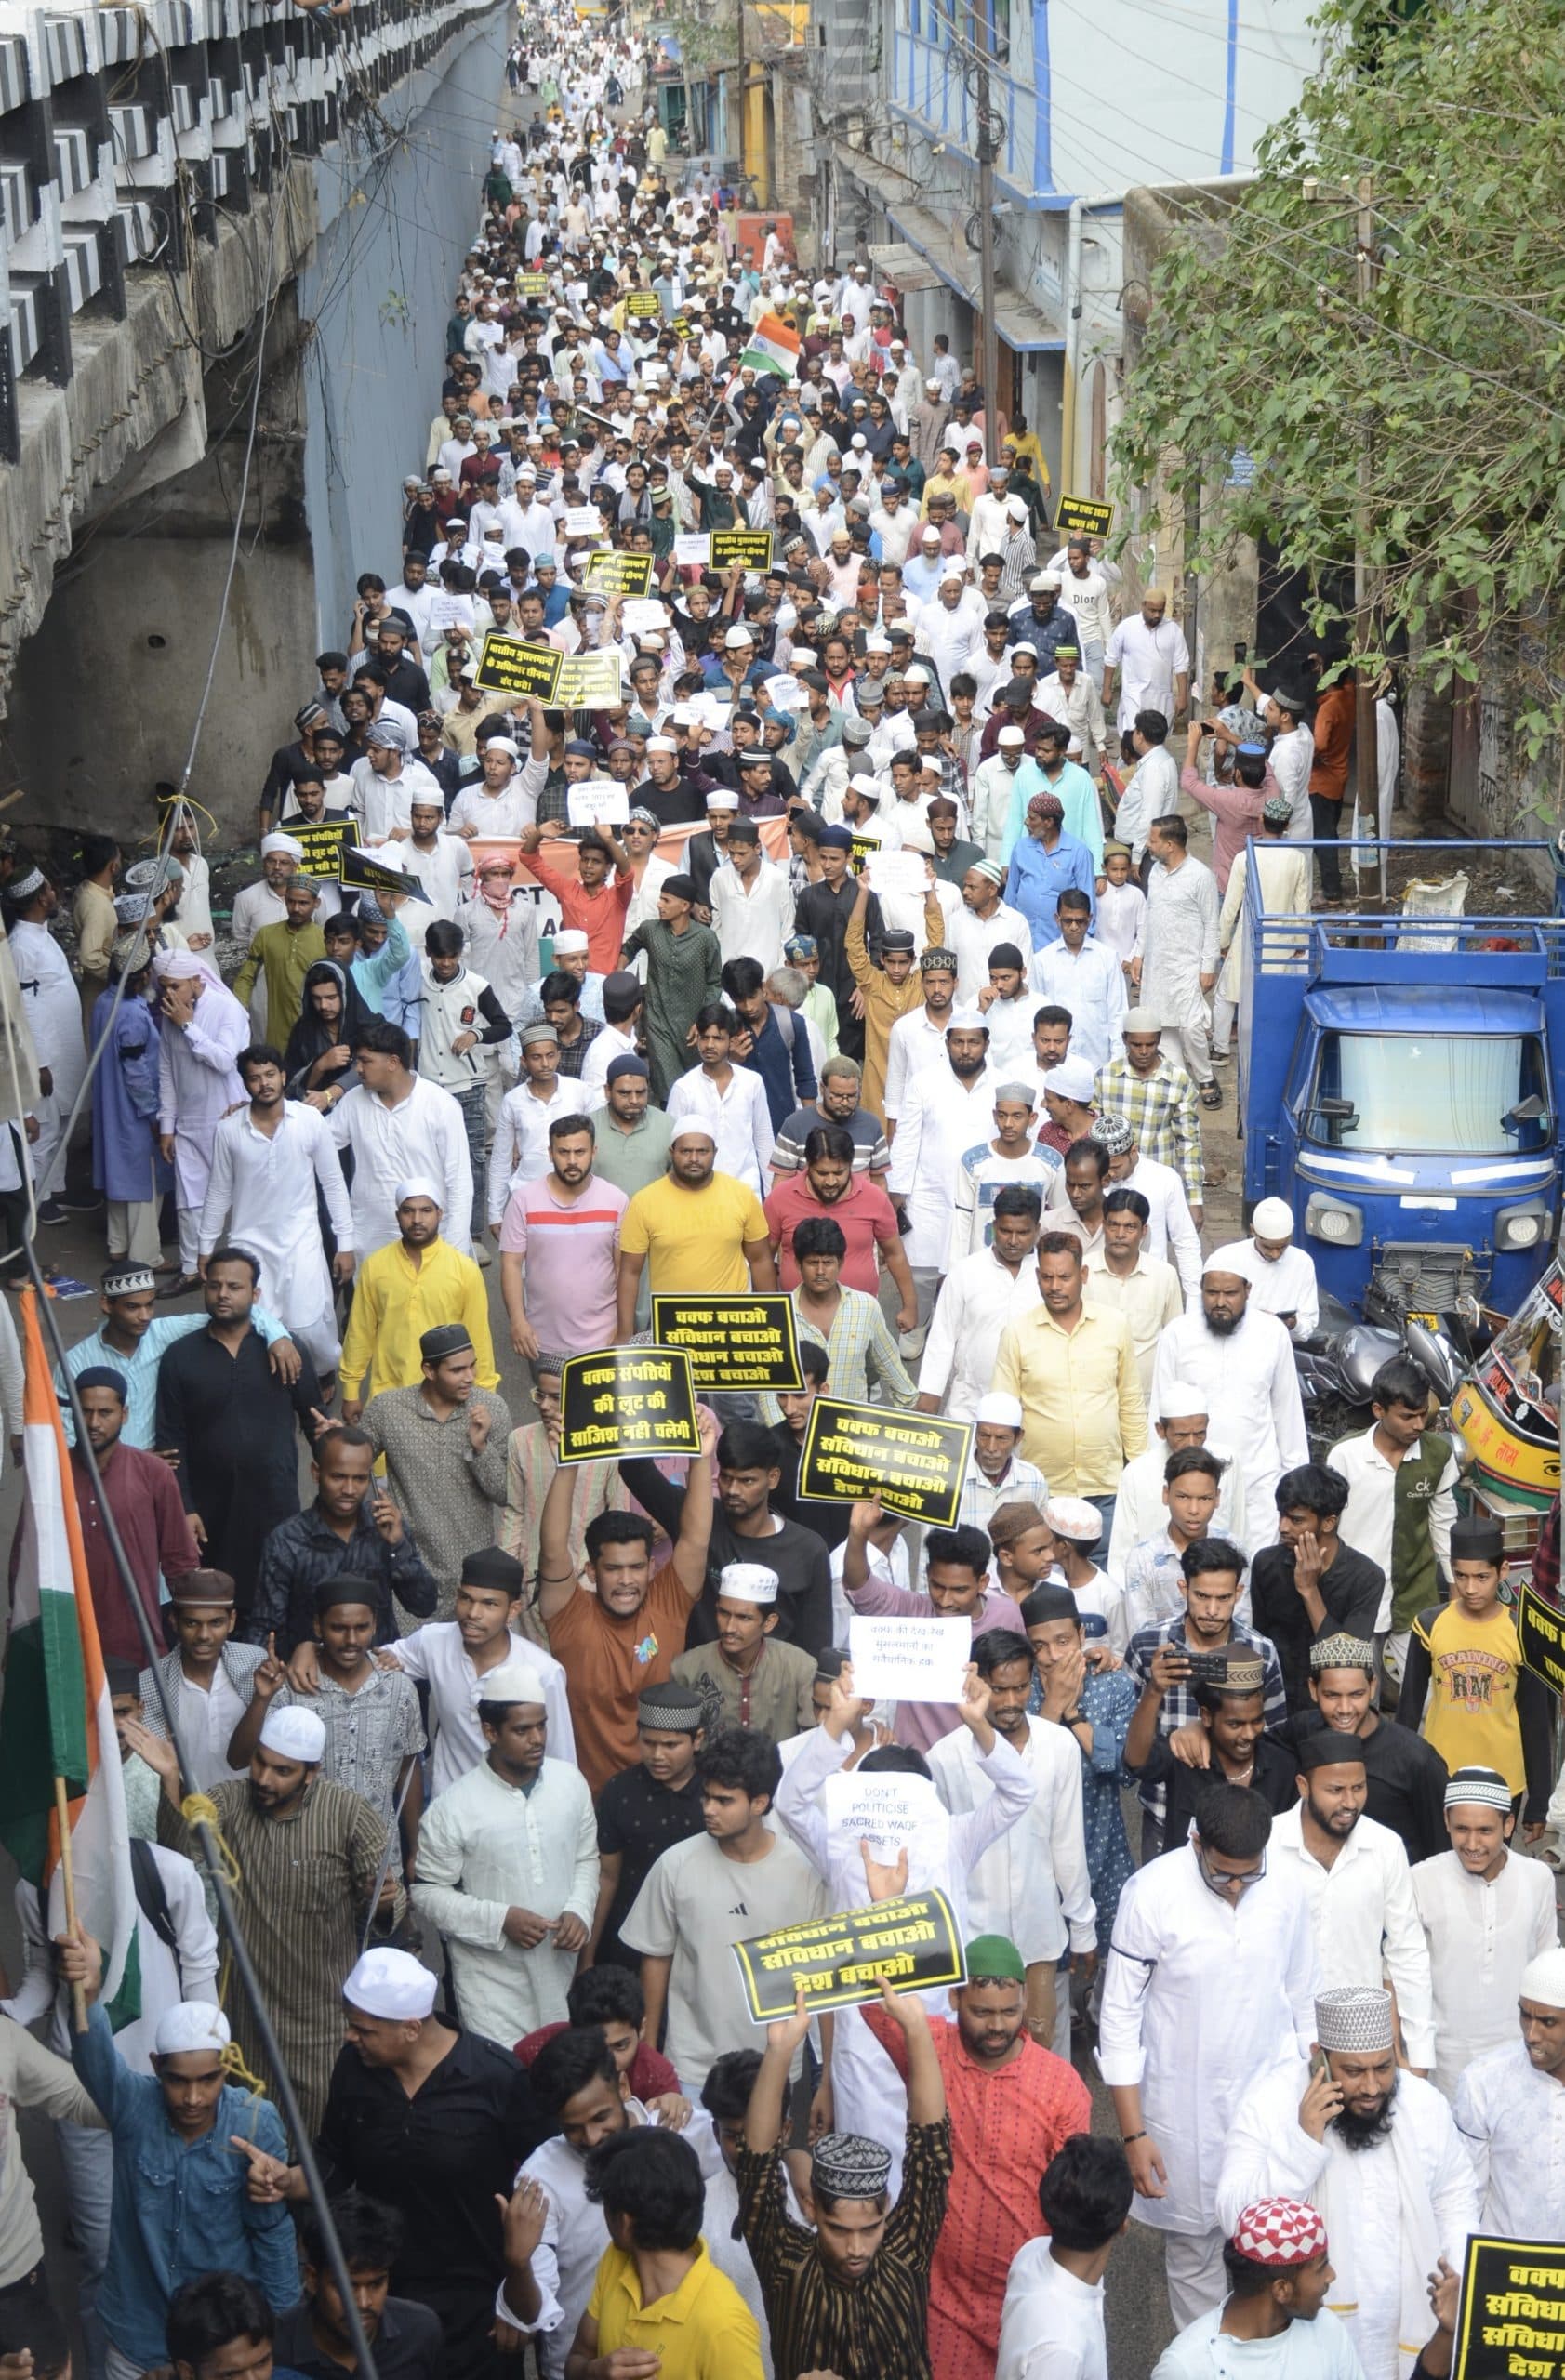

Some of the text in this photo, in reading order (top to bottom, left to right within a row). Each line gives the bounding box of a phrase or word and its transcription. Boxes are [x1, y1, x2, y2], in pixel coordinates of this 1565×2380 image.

[1073, 594, 1095, 604] Dior
[675, 1307, 768, 1324] वक्फ बचाओ
[665, 1328, 782, 1344] संविधान बचाओ
[733, 1347, 784, 1363] बचाओ
[582, 1367, 617, 1386] वक्फ
[718, 1366, 771, 1382] बचाओ
[593, 1390, 667, 1417] की लूट की
[570, 1425, 620, 1447] साजिश
[654, 1420, 691, 1439] चलेगी
[836, 1417, 943, 1449] वक्फ बचाओ
[819, 1435, 952, 1473] संविधान बचाओ
[816, 1456, 948, 1494] संविधान बचाओ
[1415, 1476, 1431, 1492] ck
[833, 1479, 865, 1495] देश
[1439, 1651, 1509, 1674] TRAINING
[865, 1786, 898, 1798] DON'T
[852, 1802, 908, 1815] POLITICISE
[842, 1817, 884, 1829] SACRED
[860, 1833, 901, 1846] ASSETS
[761, 1920, 936, 1971] संविधान बचाओ
[792, 1951, 916, 1993] देश बचाओ
[1486, 2292, 1565, 2321] संविधा
[1482, 2323, 1565, 2352] संविधा
[1508, 2353, 1556, 2379] देश
